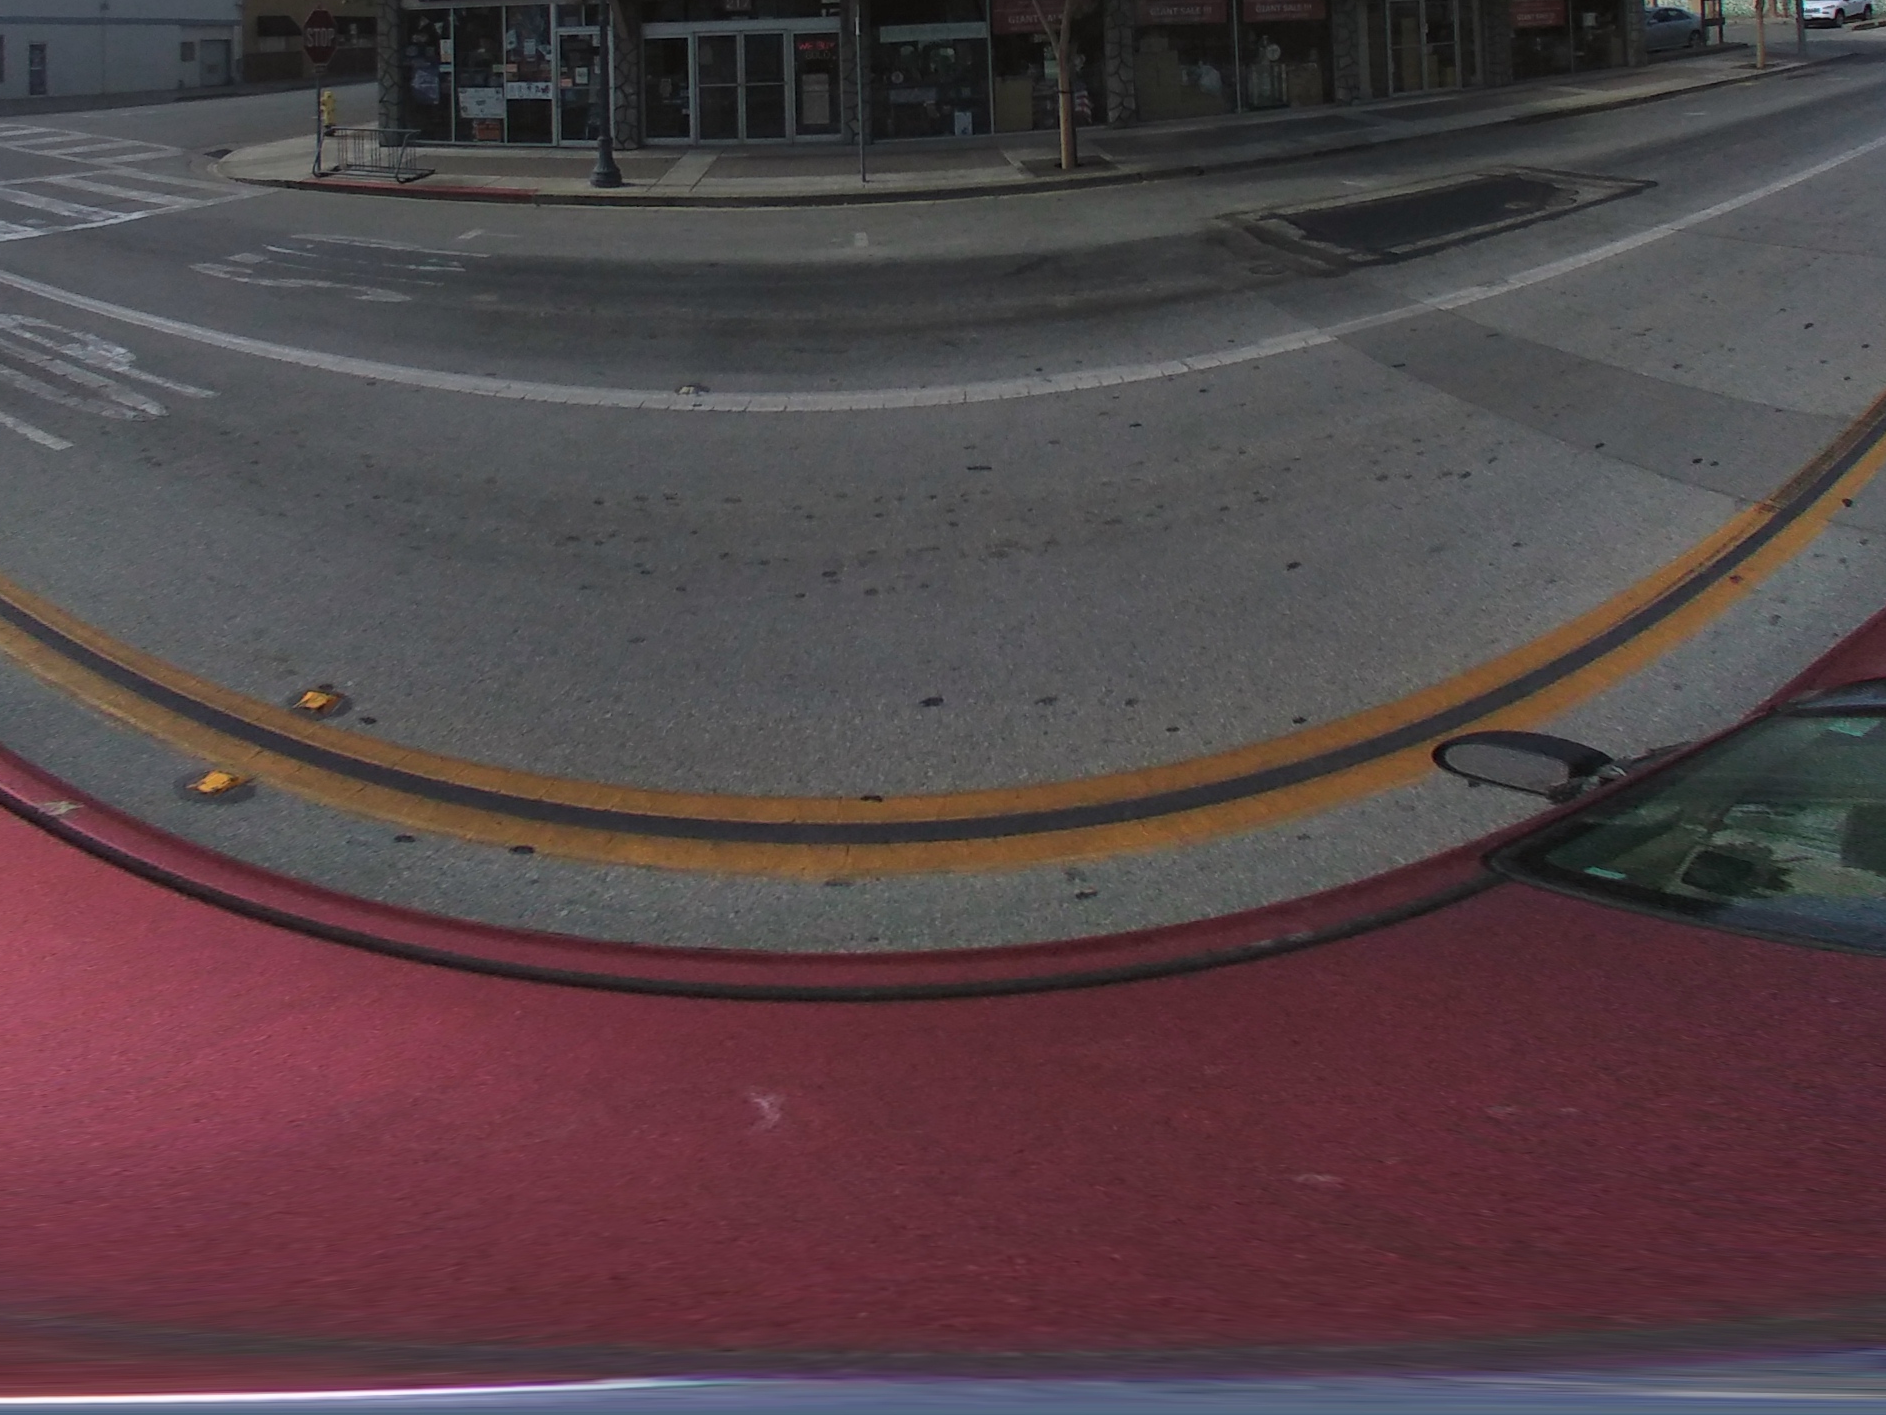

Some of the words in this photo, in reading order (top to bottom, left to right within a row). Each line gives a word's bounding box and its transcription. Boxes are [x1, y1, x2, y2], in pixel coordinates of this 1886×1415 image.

[1180, 6, 1201, 15] SALE
[1255, 4, 1281, 13] GIANT
[1008, 15, 1038, 24] GIANT
[306, 27, 335, 48] STOP
